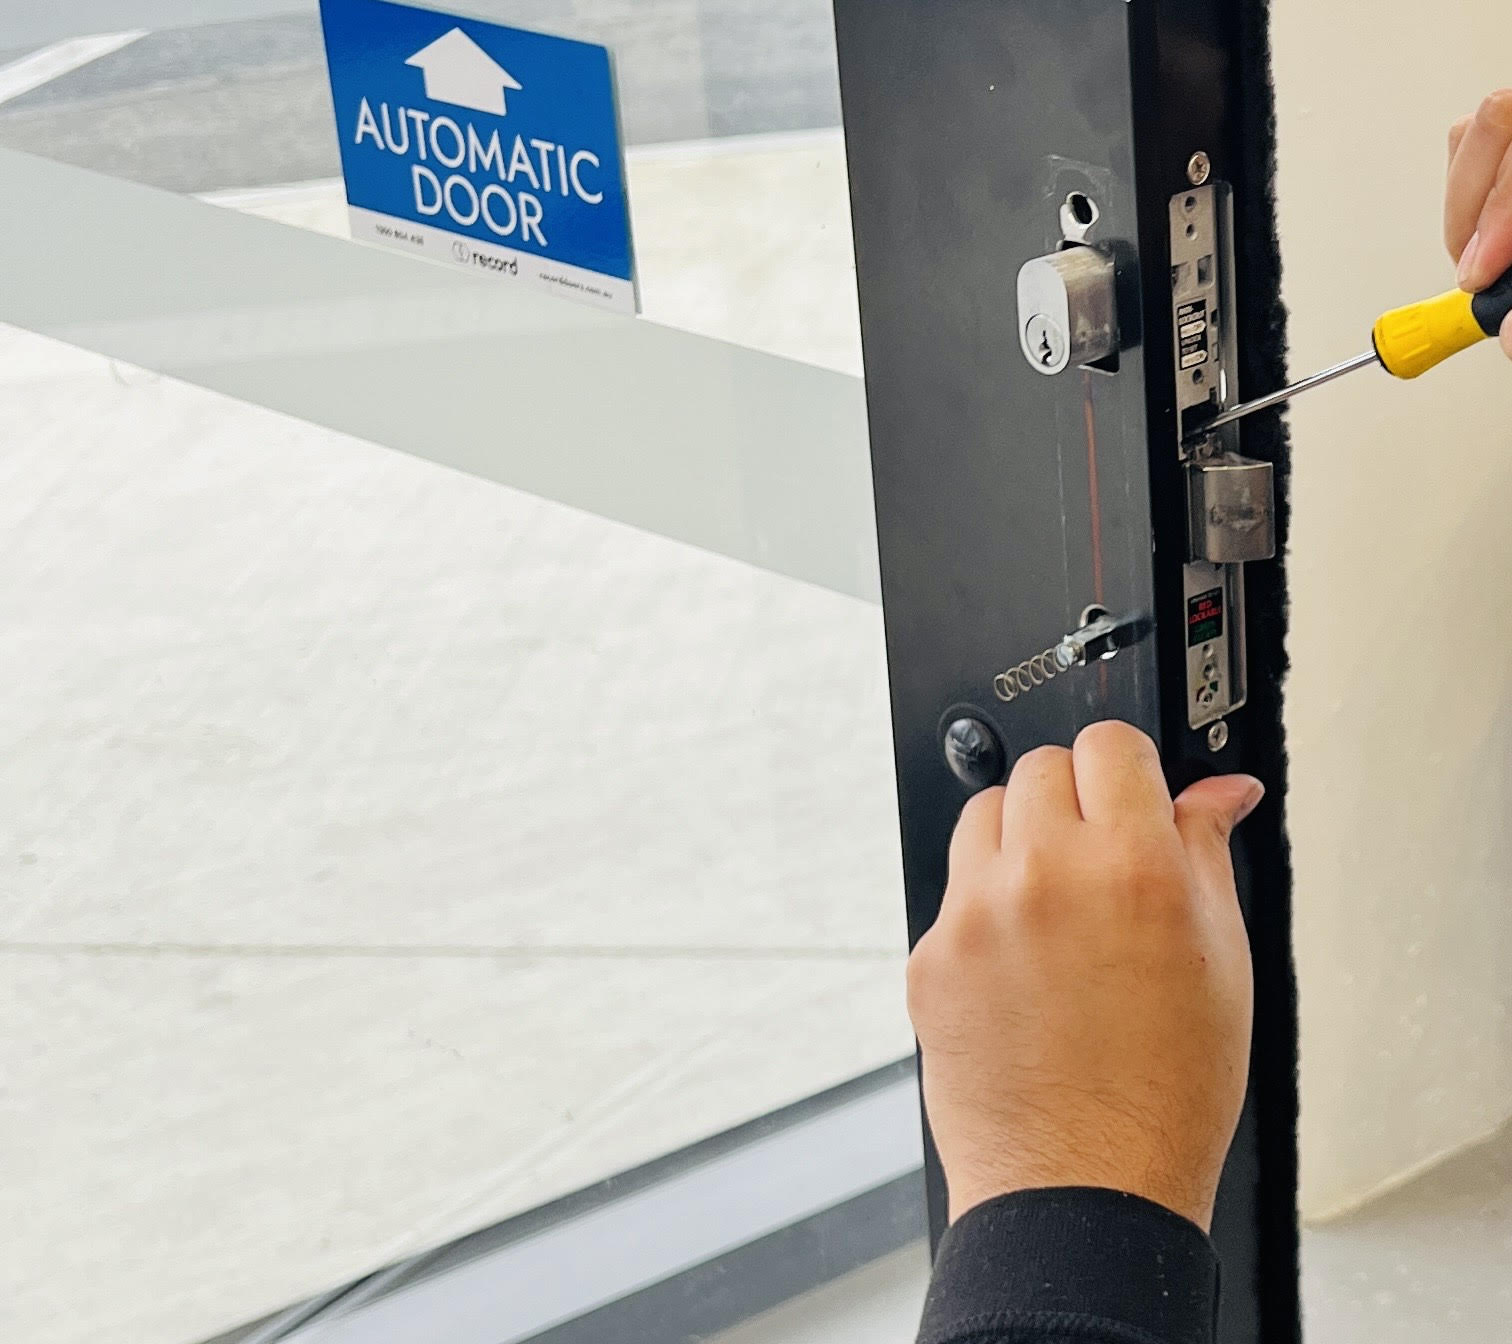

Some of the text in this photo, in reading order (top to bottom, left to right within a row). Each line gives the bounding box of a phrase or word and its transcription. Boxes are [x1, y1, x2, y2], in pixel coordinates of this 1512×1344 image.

[355, 95, 604, 205] AUTOMATIC
[412, 163, 548, 247] DOOR
[473, 251, 519, 276] record
